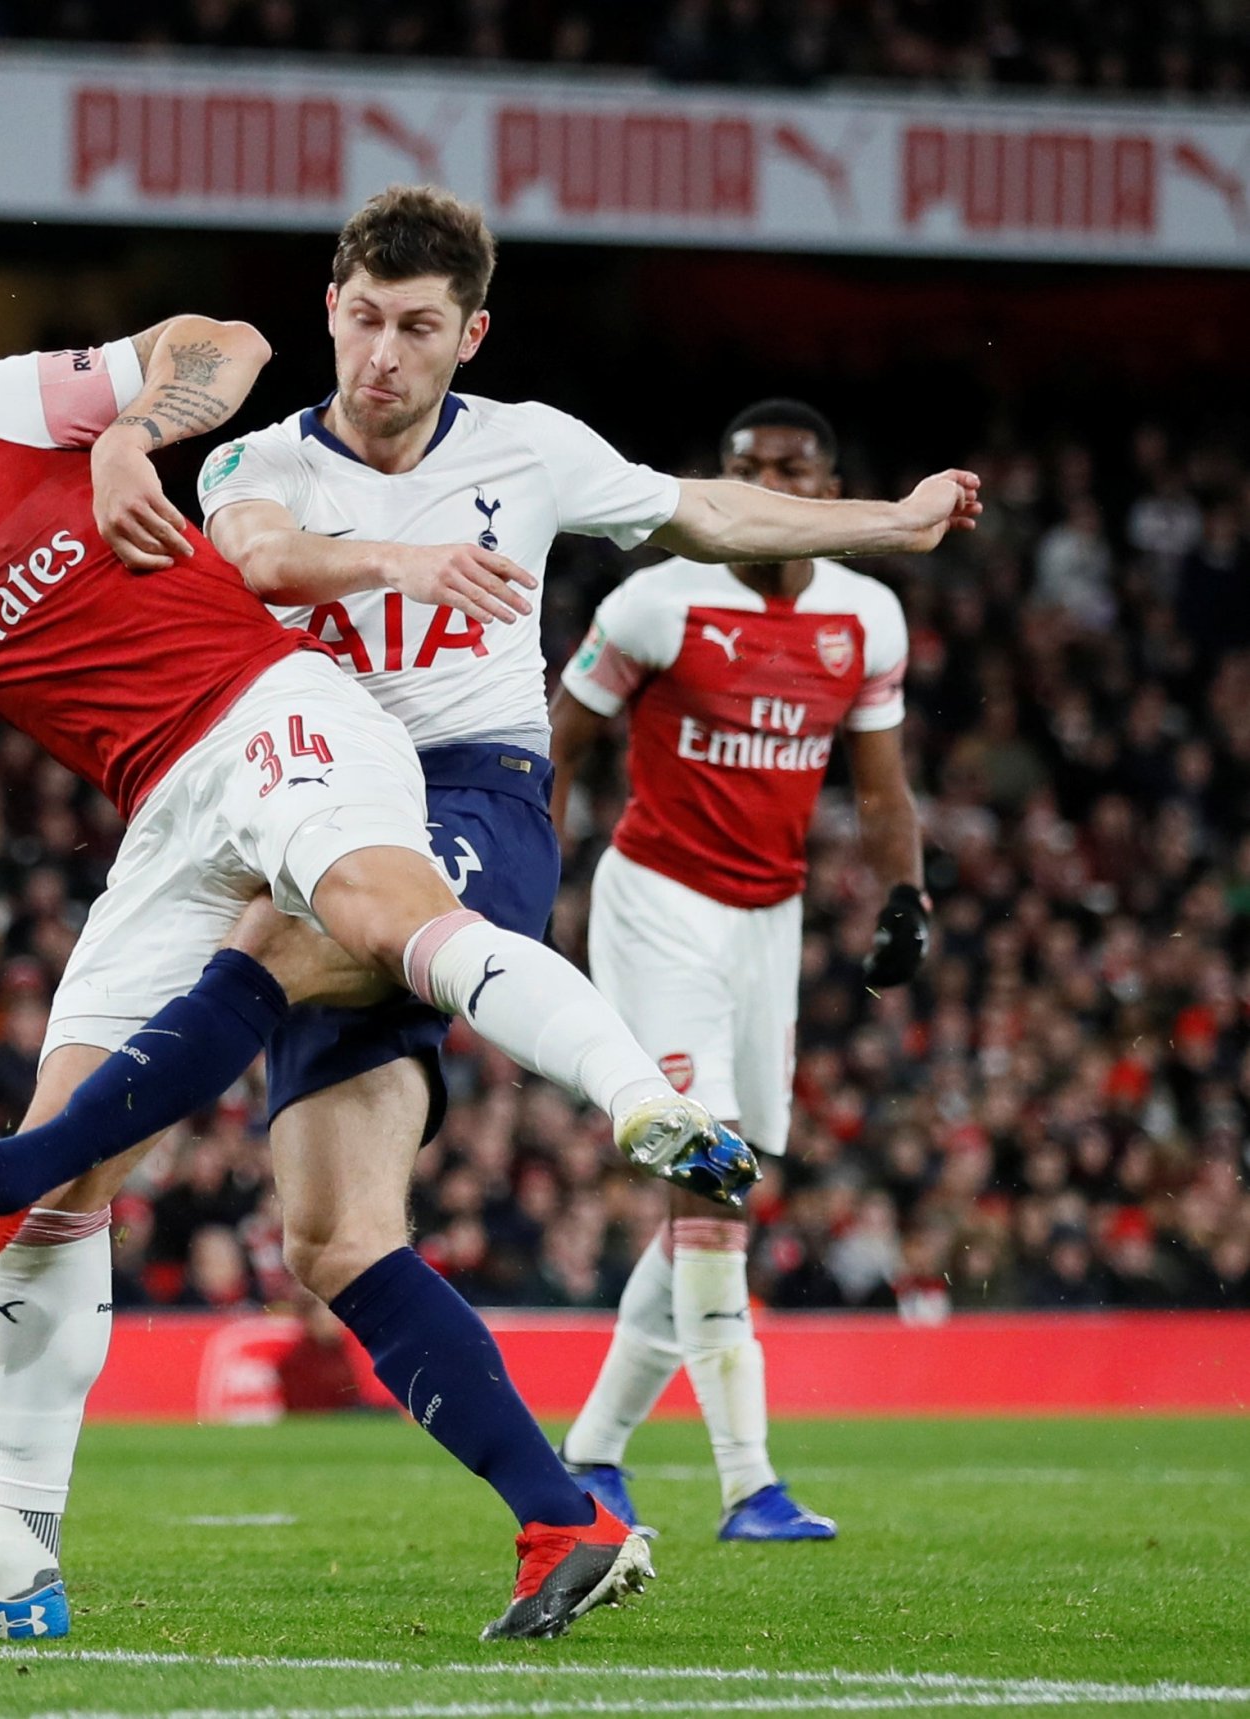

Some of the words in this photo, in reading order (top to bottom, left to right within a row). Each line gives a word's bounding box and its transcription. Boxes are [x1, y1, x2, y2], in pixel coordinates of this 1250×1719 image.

[72, 86, 344, 201] PUMA
[492, 106, 756, 217] PUMA
[900, 126, 1158, 235] PUMA
[308, 591, 489, 674] AIA
[245, 714, 334, 799] 34
[750, 697, 807, 736] Fly
[421, 1393, 443, 1430] URS
